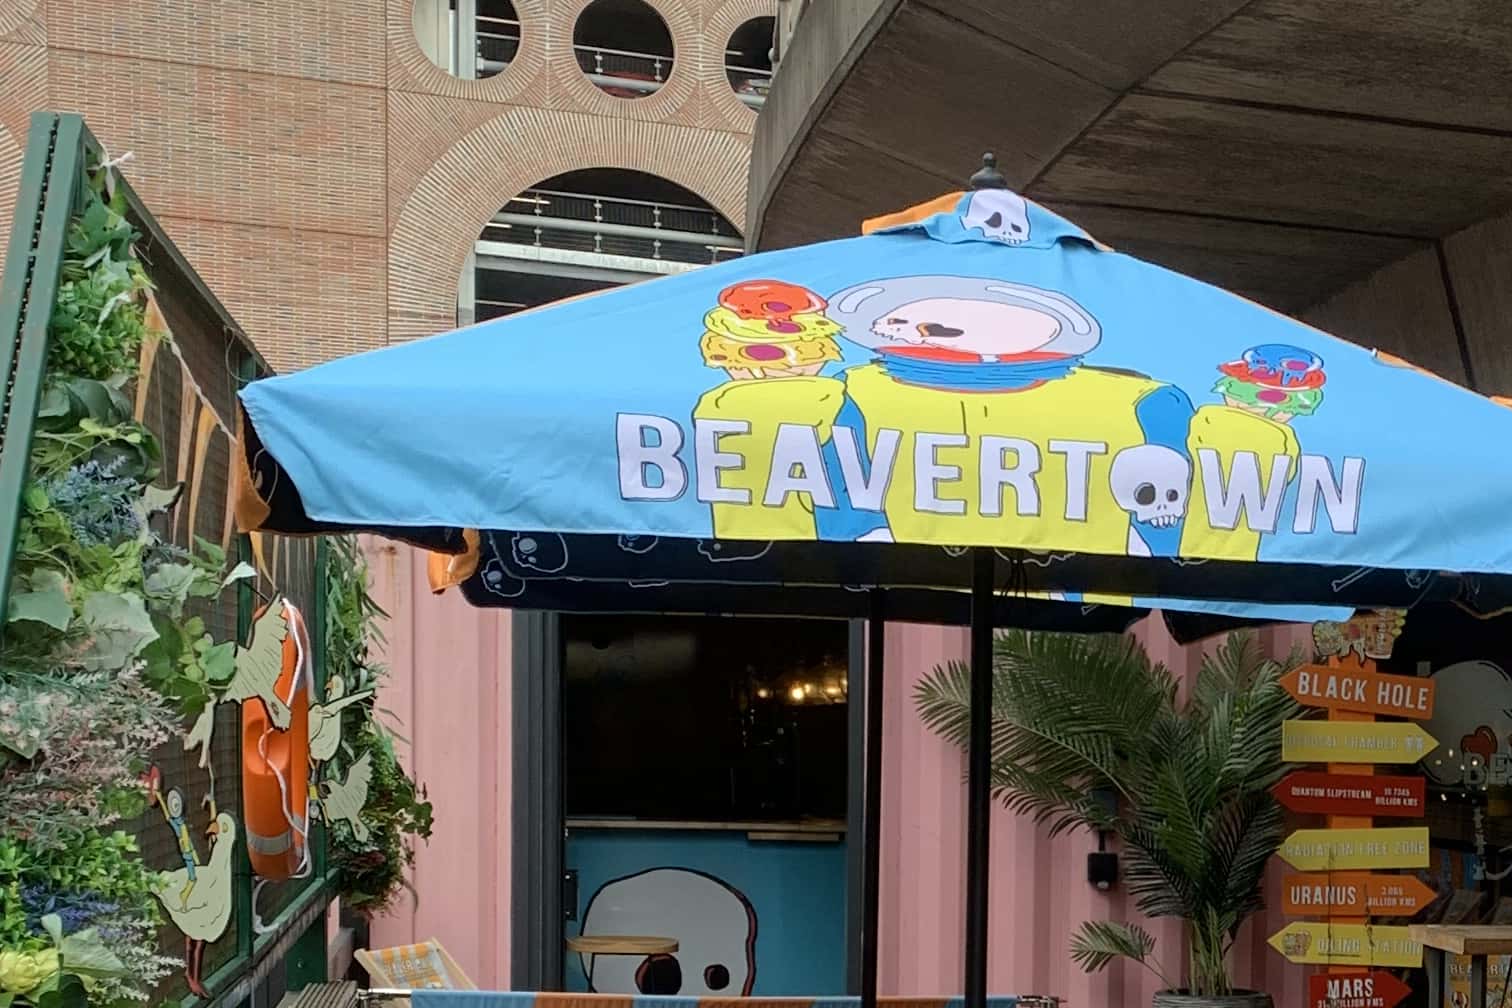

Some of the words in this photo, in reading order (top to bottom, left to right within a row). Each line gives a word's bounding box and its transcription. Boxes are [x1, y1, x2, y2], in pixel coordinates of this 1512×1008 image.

[615, 412, 1366, 535] BEAVERTOWN
[1297, 671, 1366, 703] BLACK
[1377, 681, 1428, 711] HOLE
[1327, 787, 1372, 799] SLIPSTREAM
[1291, 885, 1356, 905] URANUS
[1327, 978, 1373, 999] MARS
